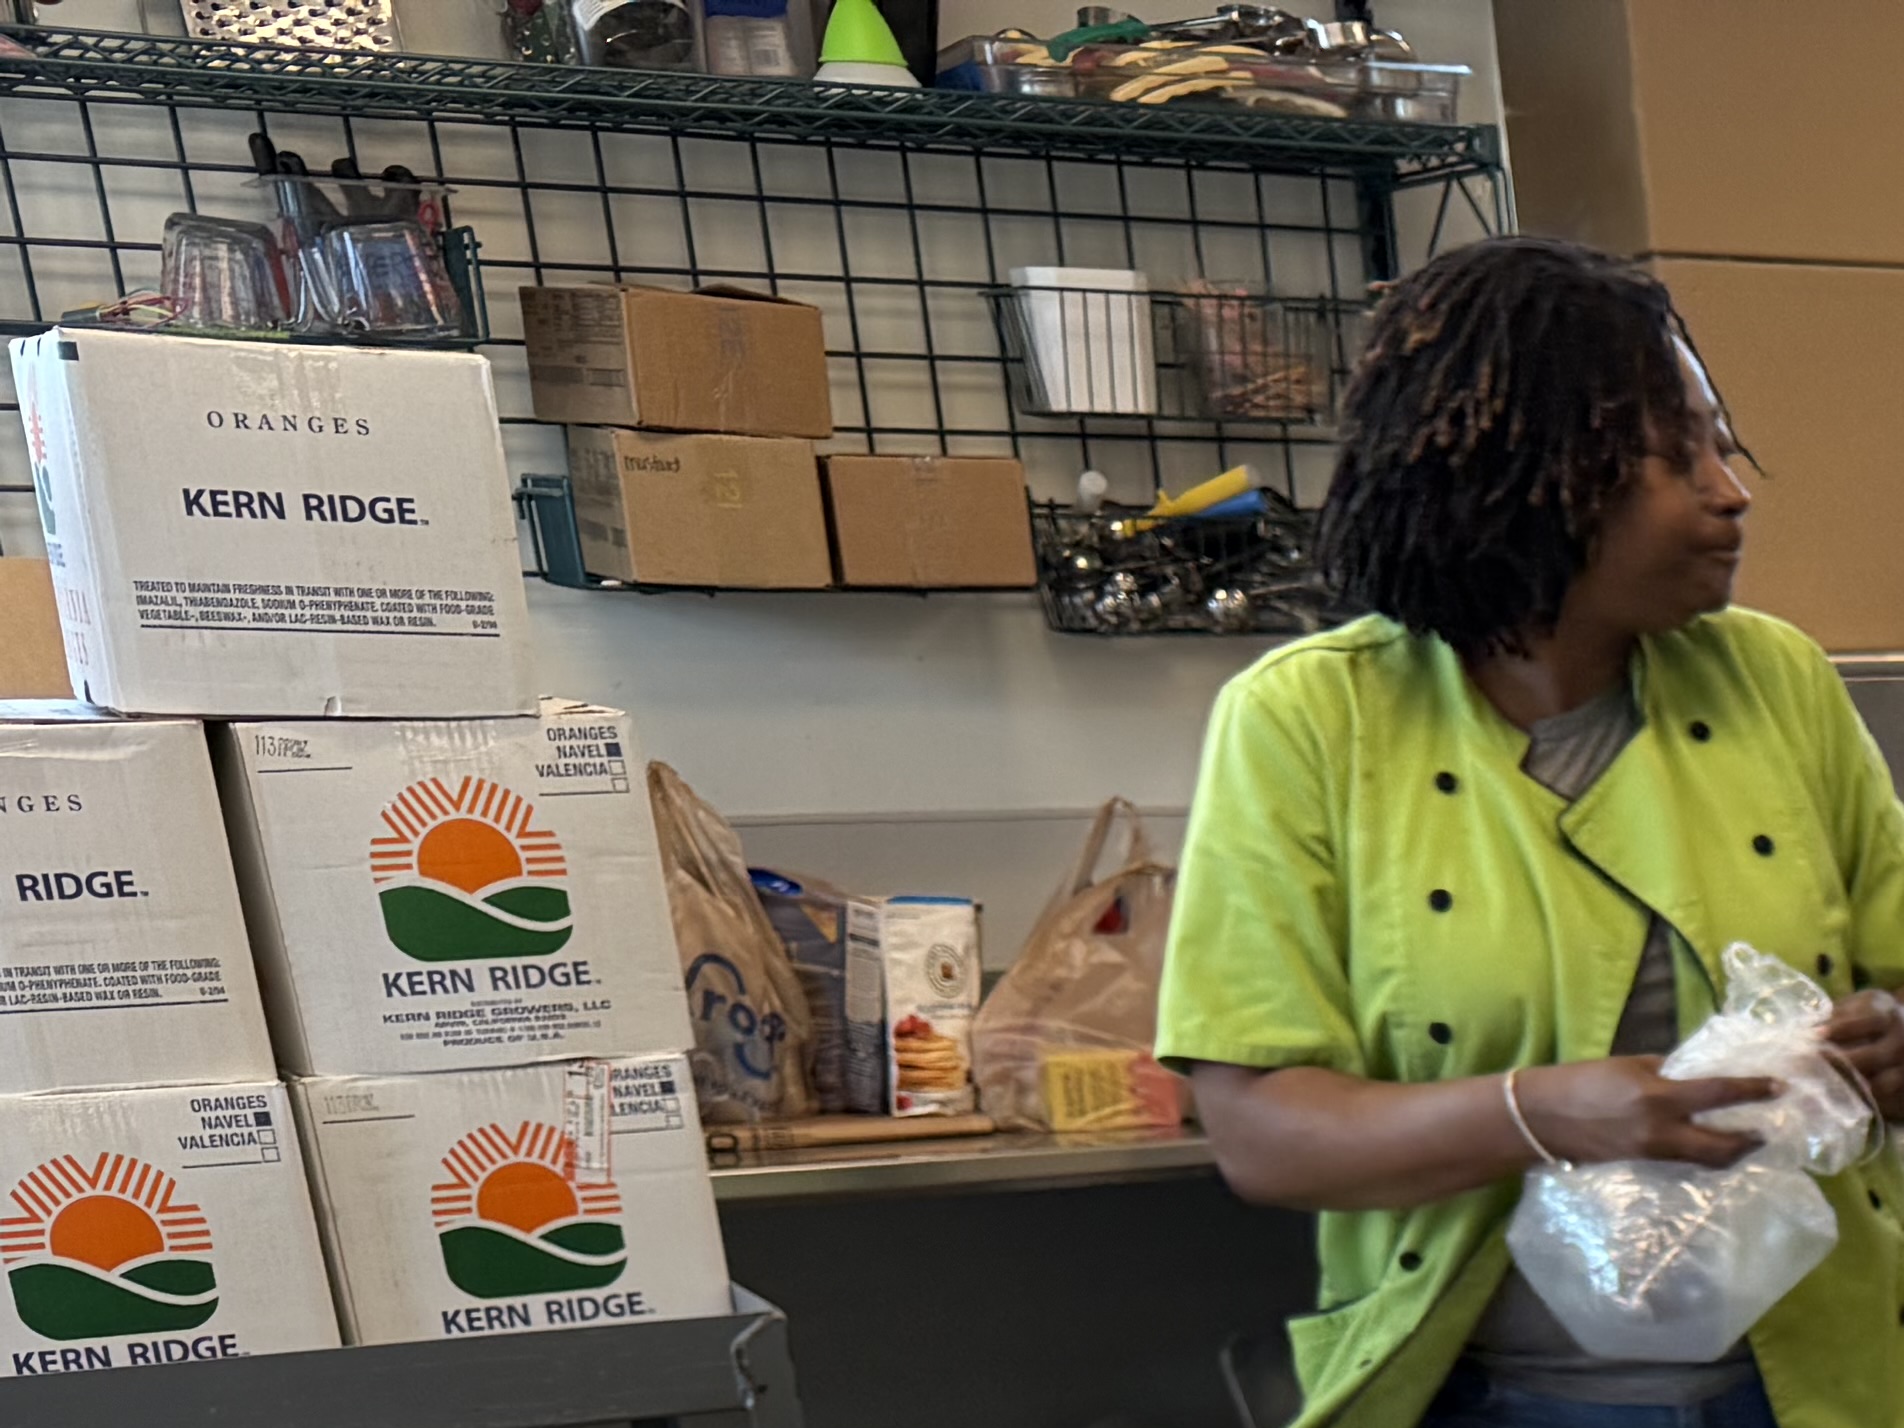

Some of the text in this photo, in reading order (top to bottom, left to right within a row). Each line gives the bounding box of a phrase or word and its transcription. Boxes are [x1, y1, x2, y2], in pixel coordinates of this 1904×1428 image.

[207, 410, 370, 436] ORANGES
[182, 487, 419, 526] KERN RIDGE
[546, 726, 619, 742] ORANGES
[556, 743, 605, 760] NAVEL
[535, 762, 609, 778] VALENCIA
[15, 869, 139, 902] RIDGE
[382, 960, 593, 998] KERN RIDGE
[382, 1012, 431, 1024] KERN
[435, 1009, 486, 1021] RIDGE
[611, 1064, 673, 1081] RANGES
[190, 1094, 268, 1113] ORANGES
[201, 1113, 254, 1131] NAVEL
[178, 1132, 259, 1151] VALENCIA
[441, 1291, 648, 1336] KERN RIDGE
[12, 1334, 242, 1376] KERN RIDGE
